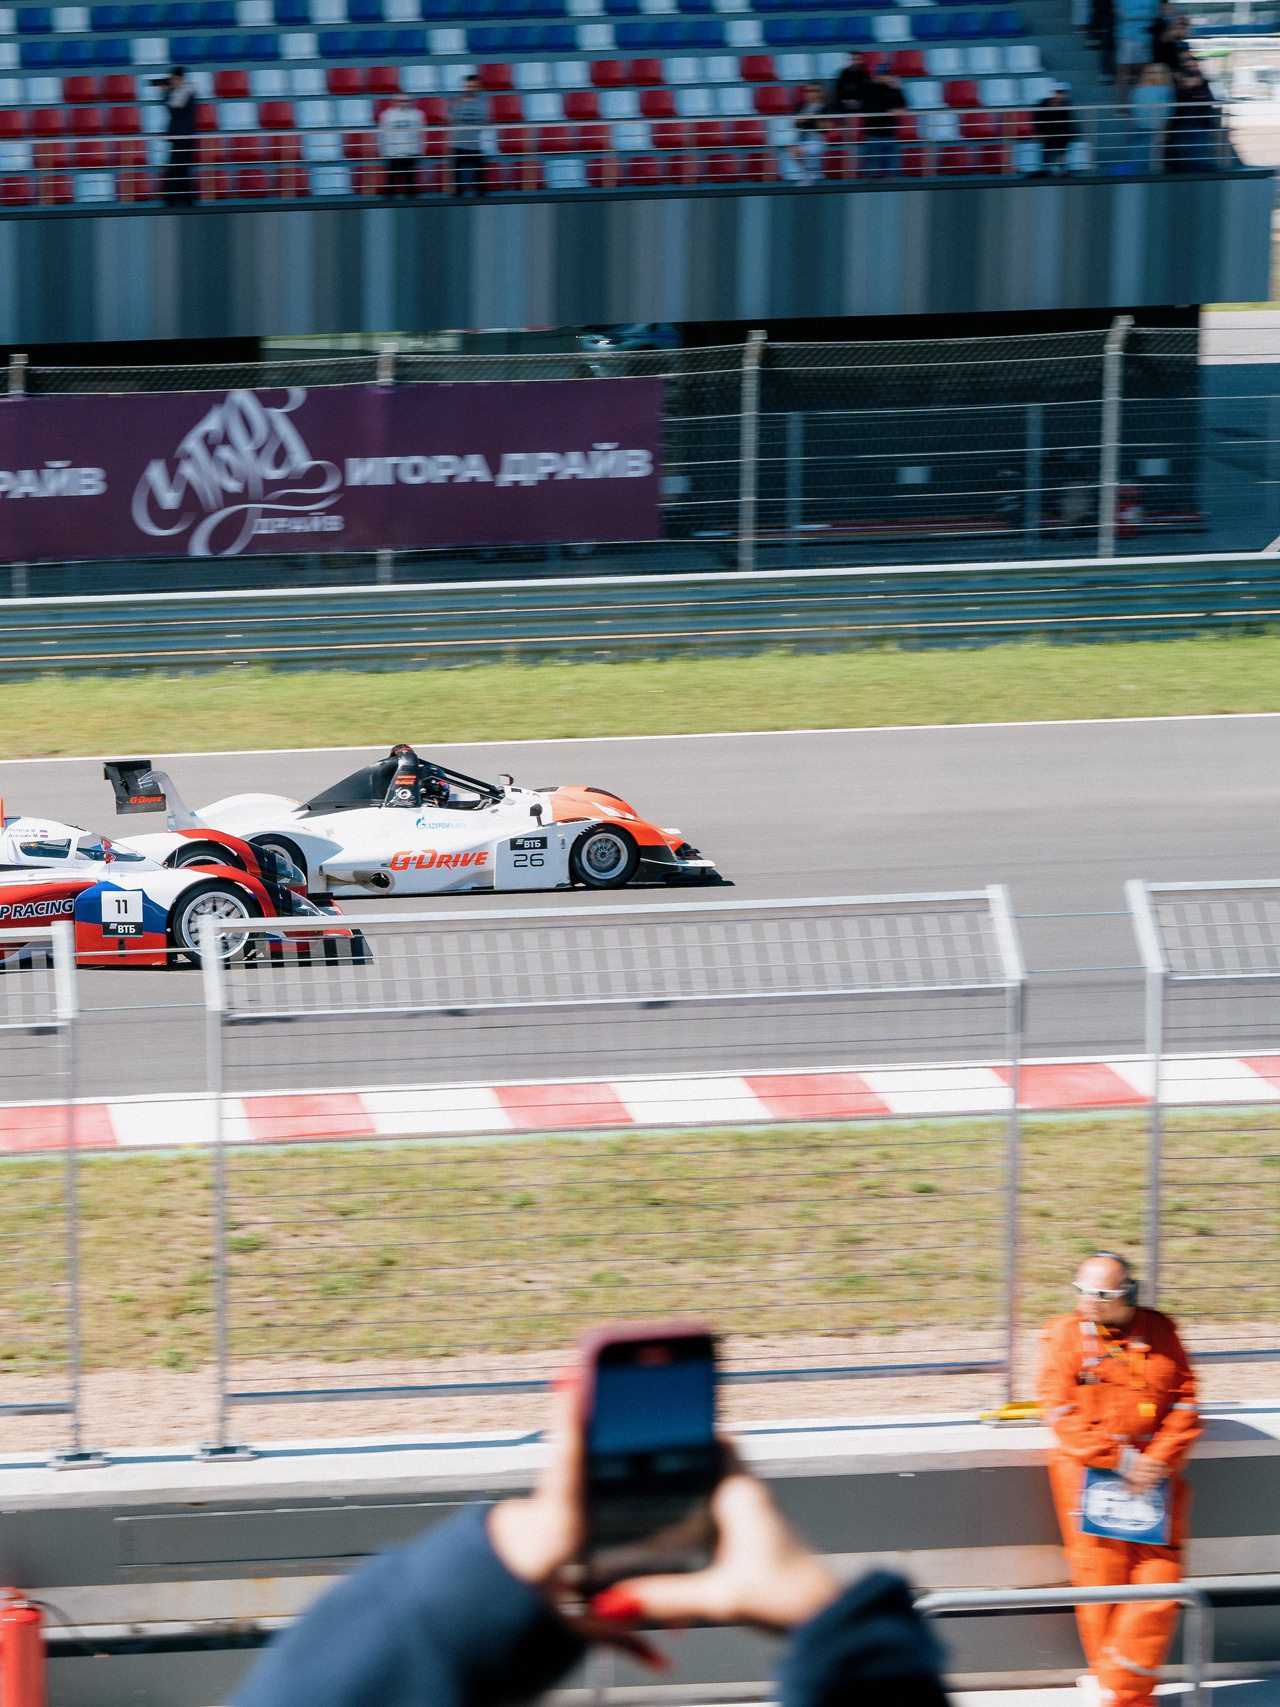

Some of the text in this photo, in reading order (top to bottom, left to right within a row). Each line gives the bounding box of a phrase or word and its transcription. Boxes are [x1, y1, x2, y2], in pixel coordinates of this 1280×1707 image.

[345, 443, 654, 487] ИГОРА ДРАЙВ
[253, 512, 344, 534] ДРАЙВ
[523, 840, 542, 849] ВТБ
[513, 853, 545, 868] 26
[11, 899, 75, 920] RACING
[115, 899, 128, 915] 11
[117, 925, 136, 934] ВТБ
